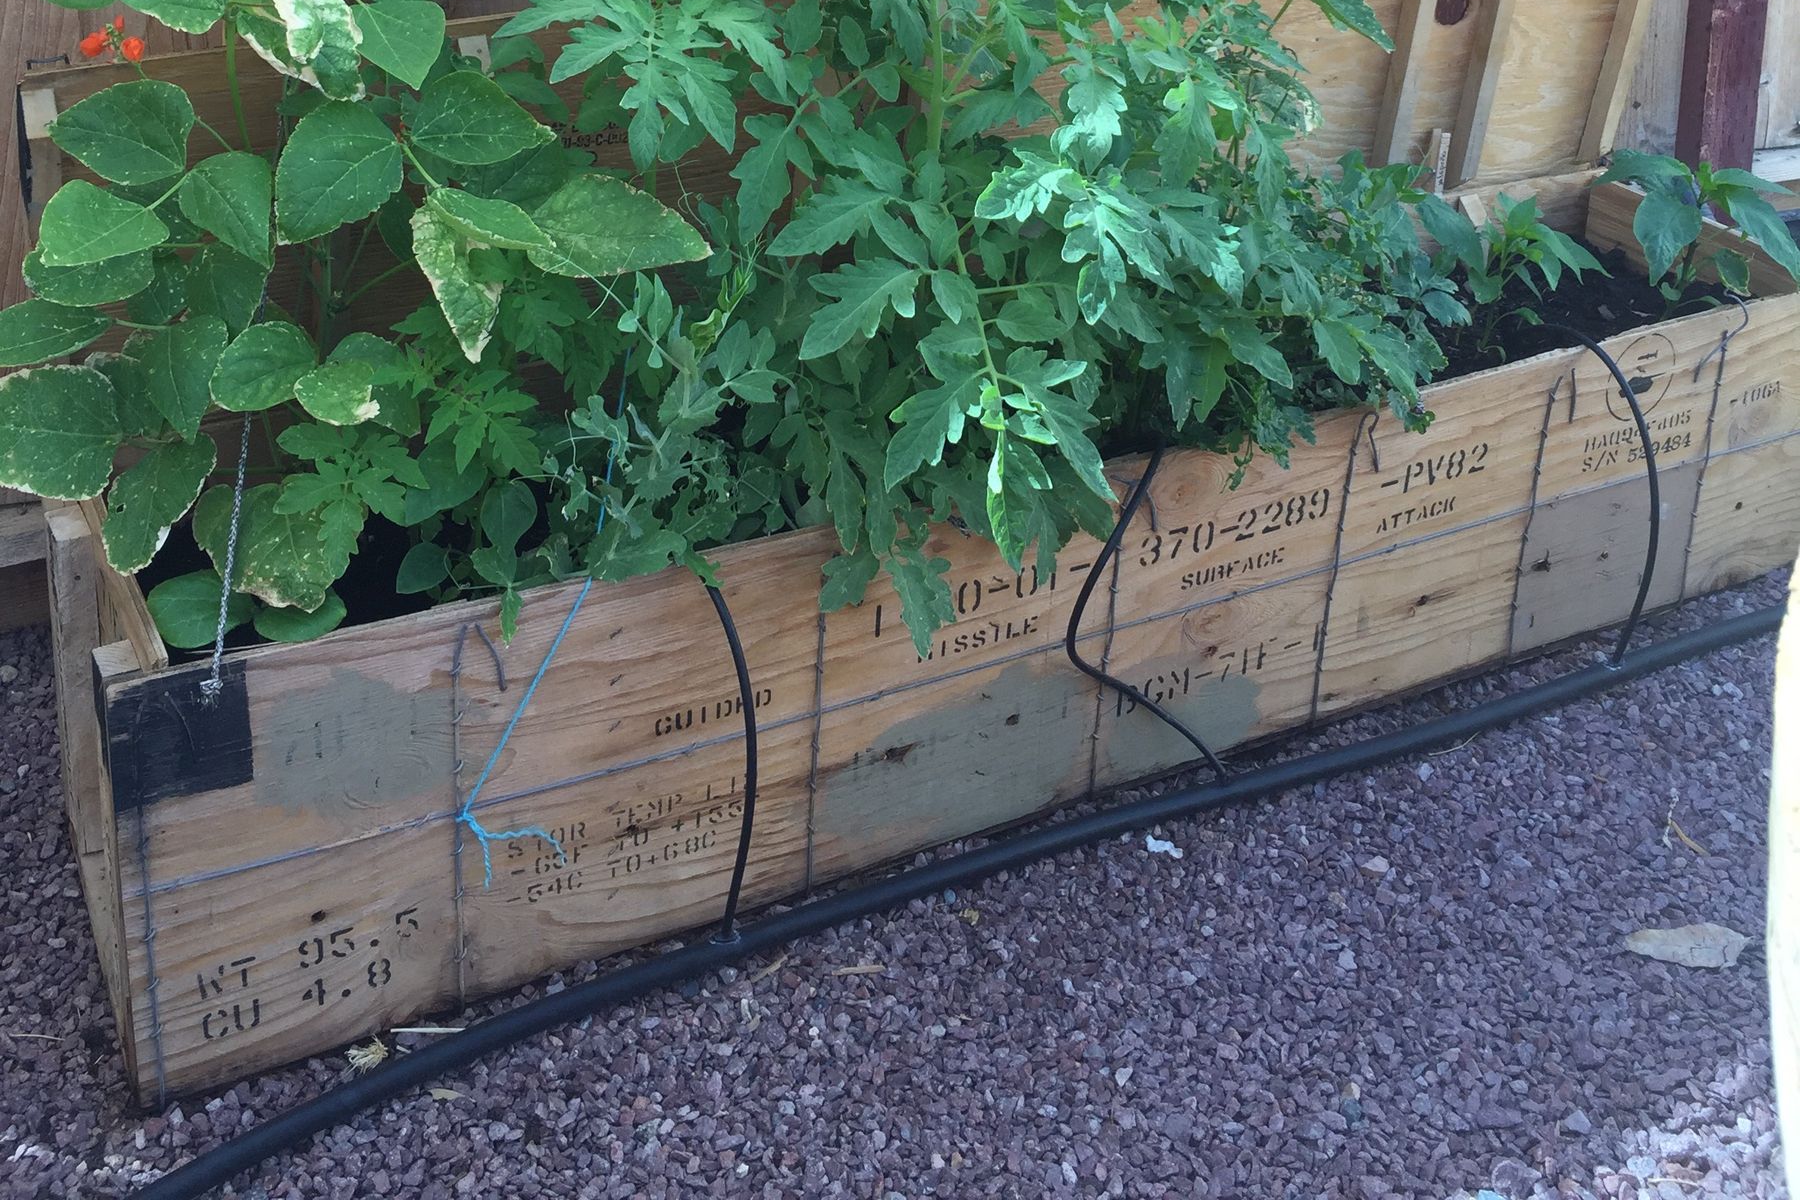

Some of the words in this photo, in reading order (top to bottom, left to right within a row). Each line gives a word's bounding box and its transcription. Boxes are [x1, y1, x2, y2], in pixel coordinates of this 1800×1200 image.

[1582, 450, 1619, 473] S/N
[1627, 432, 1691, 463] 529484
[1139, 488, 1330, 567] 370-2289
[1380, 442, 1489, 494] -PV82
[1180, 547, 1285, 590] SURFACE
[1376, 496, 1457, 534] ATTACK
[672, 794, 759, 832] +155
[299, 908, 419, 969] 95.5
[202, 998, 260, 1039] CU
[302, 958, 392, 1006] 4.8
